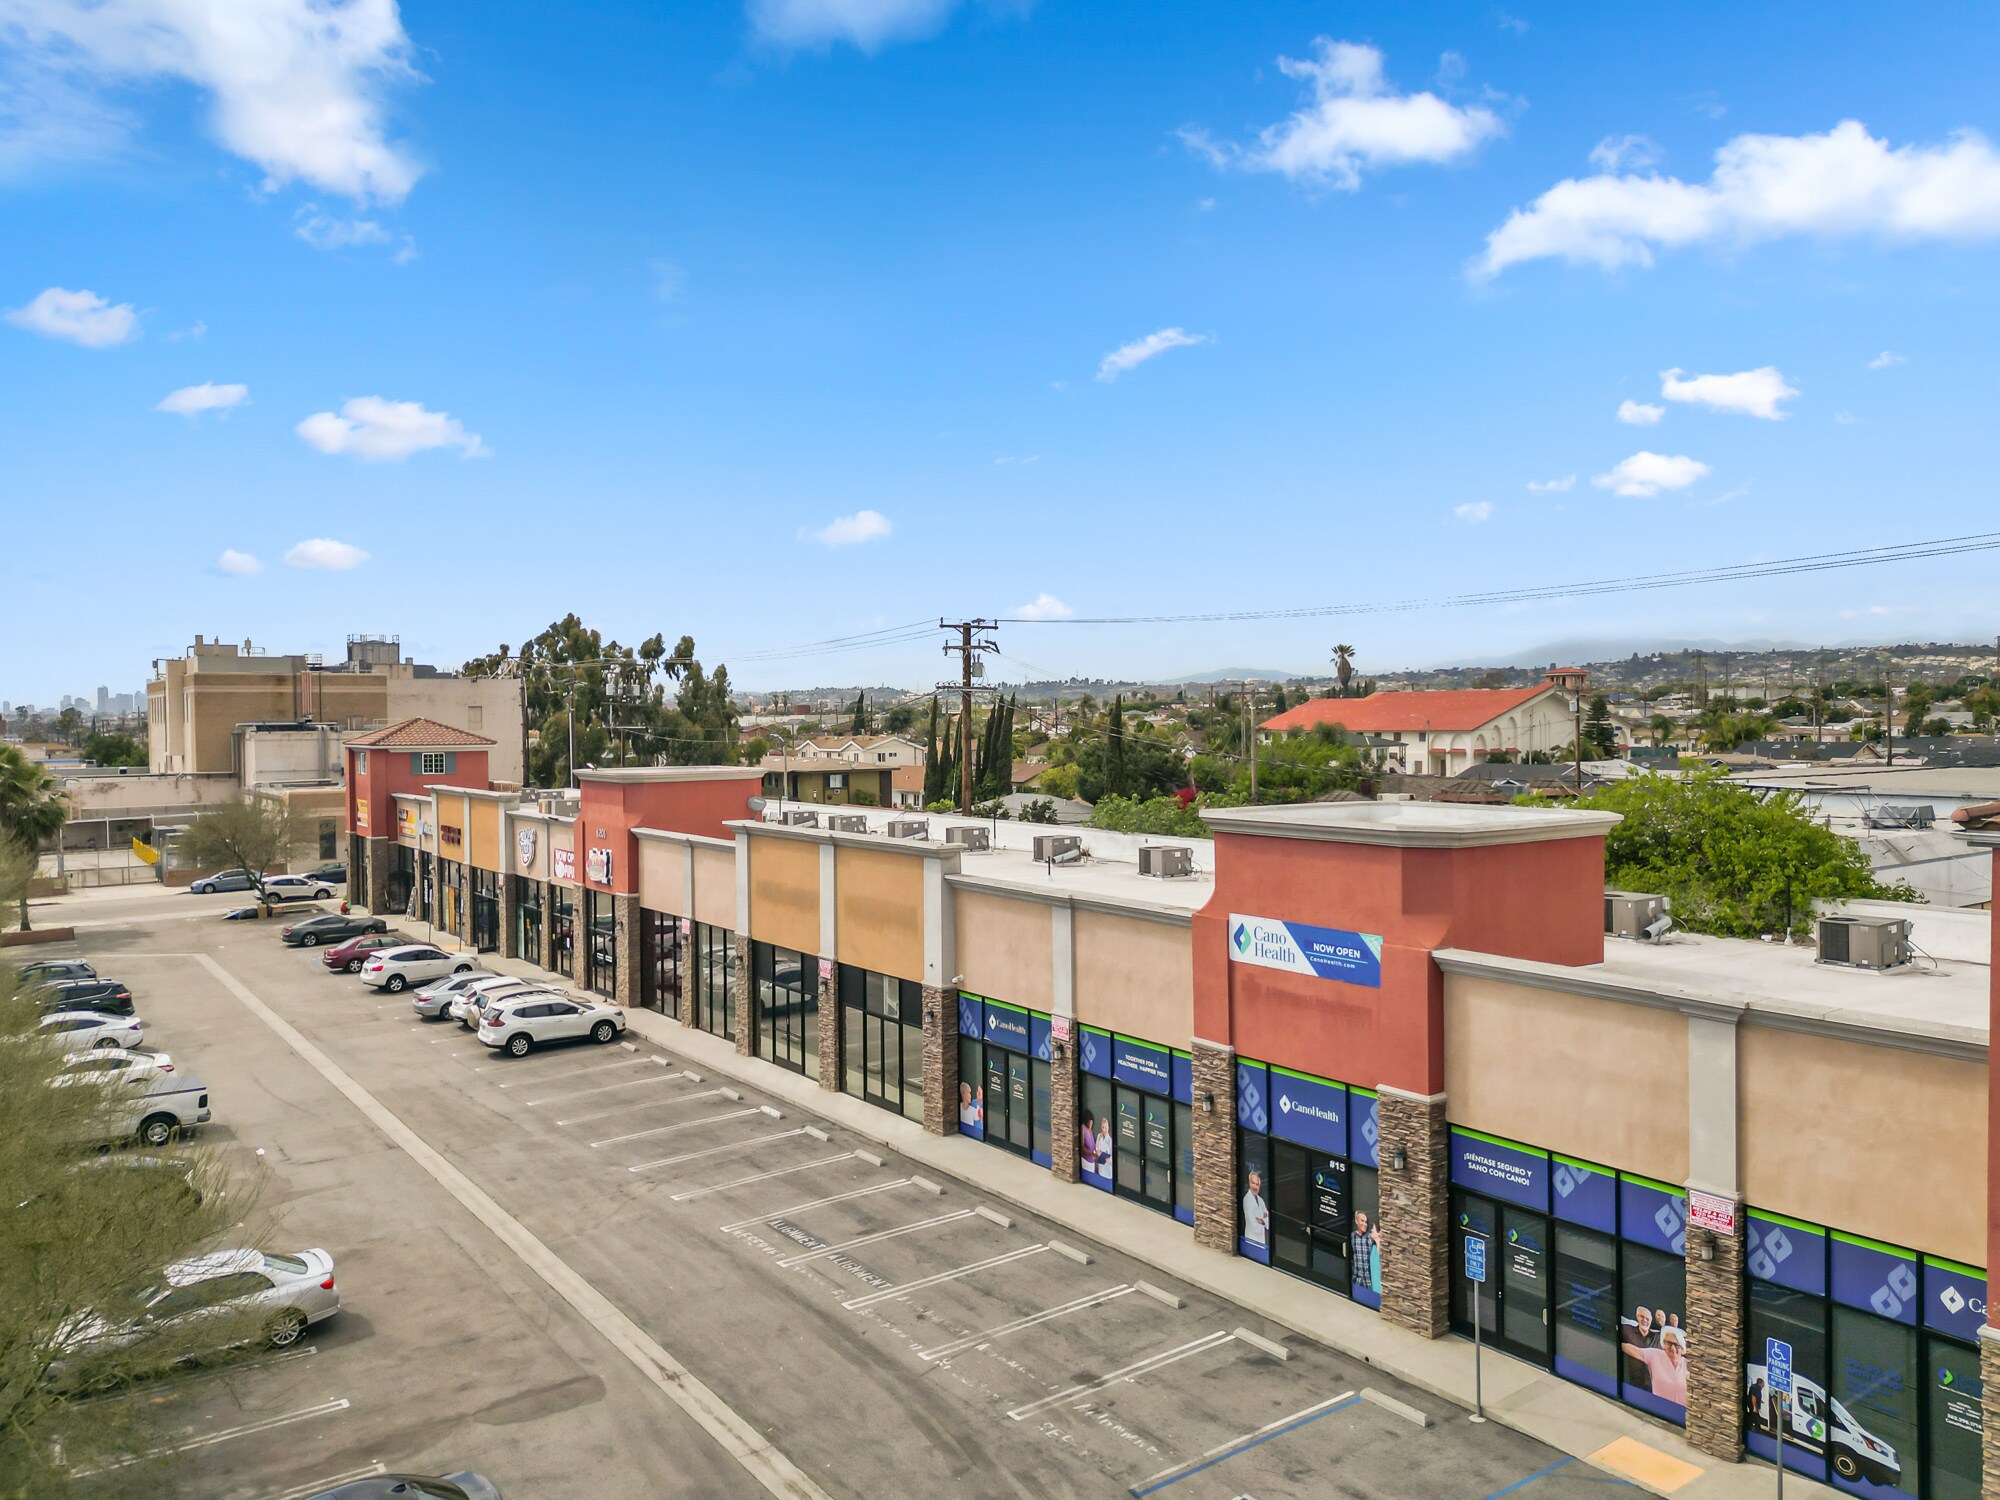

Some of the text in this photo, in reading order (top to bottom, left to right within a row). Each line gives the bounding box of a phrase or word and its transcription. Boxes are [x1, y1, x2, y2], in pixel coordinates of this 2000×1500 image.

[1253, 926, 1287, 945] Cano
[1254, 942, 1296, 963] Health
[1313, 943, 1361, 958] NOW OPEN
[1309, 956, 1356, 969] CanoHealth.com
[996, 1019, 1026, 1035] CanoHealth
[1125, 1054, 1145, 1065] TOGETHER
[1138, 1065, 1156, 1075] HAPPIER
[1291, 1100, 1339, 1123] CanoHealth
[1329, 1160, 1346, 1172] #15
[1463, 1152, 1533, 1178] ¡SIÉNTASE SEGURO Y
[1468, 1162, 1530, 1186] SANO CON CANO!
[766, 1219, 827, 1251] ALIGNMENT
[825, 1253, 893, 1289] ALIGNMENT
[1768, 1356, 1790, 1371] PARKING
[1771, 1366, 1786, 1377] ONLY
